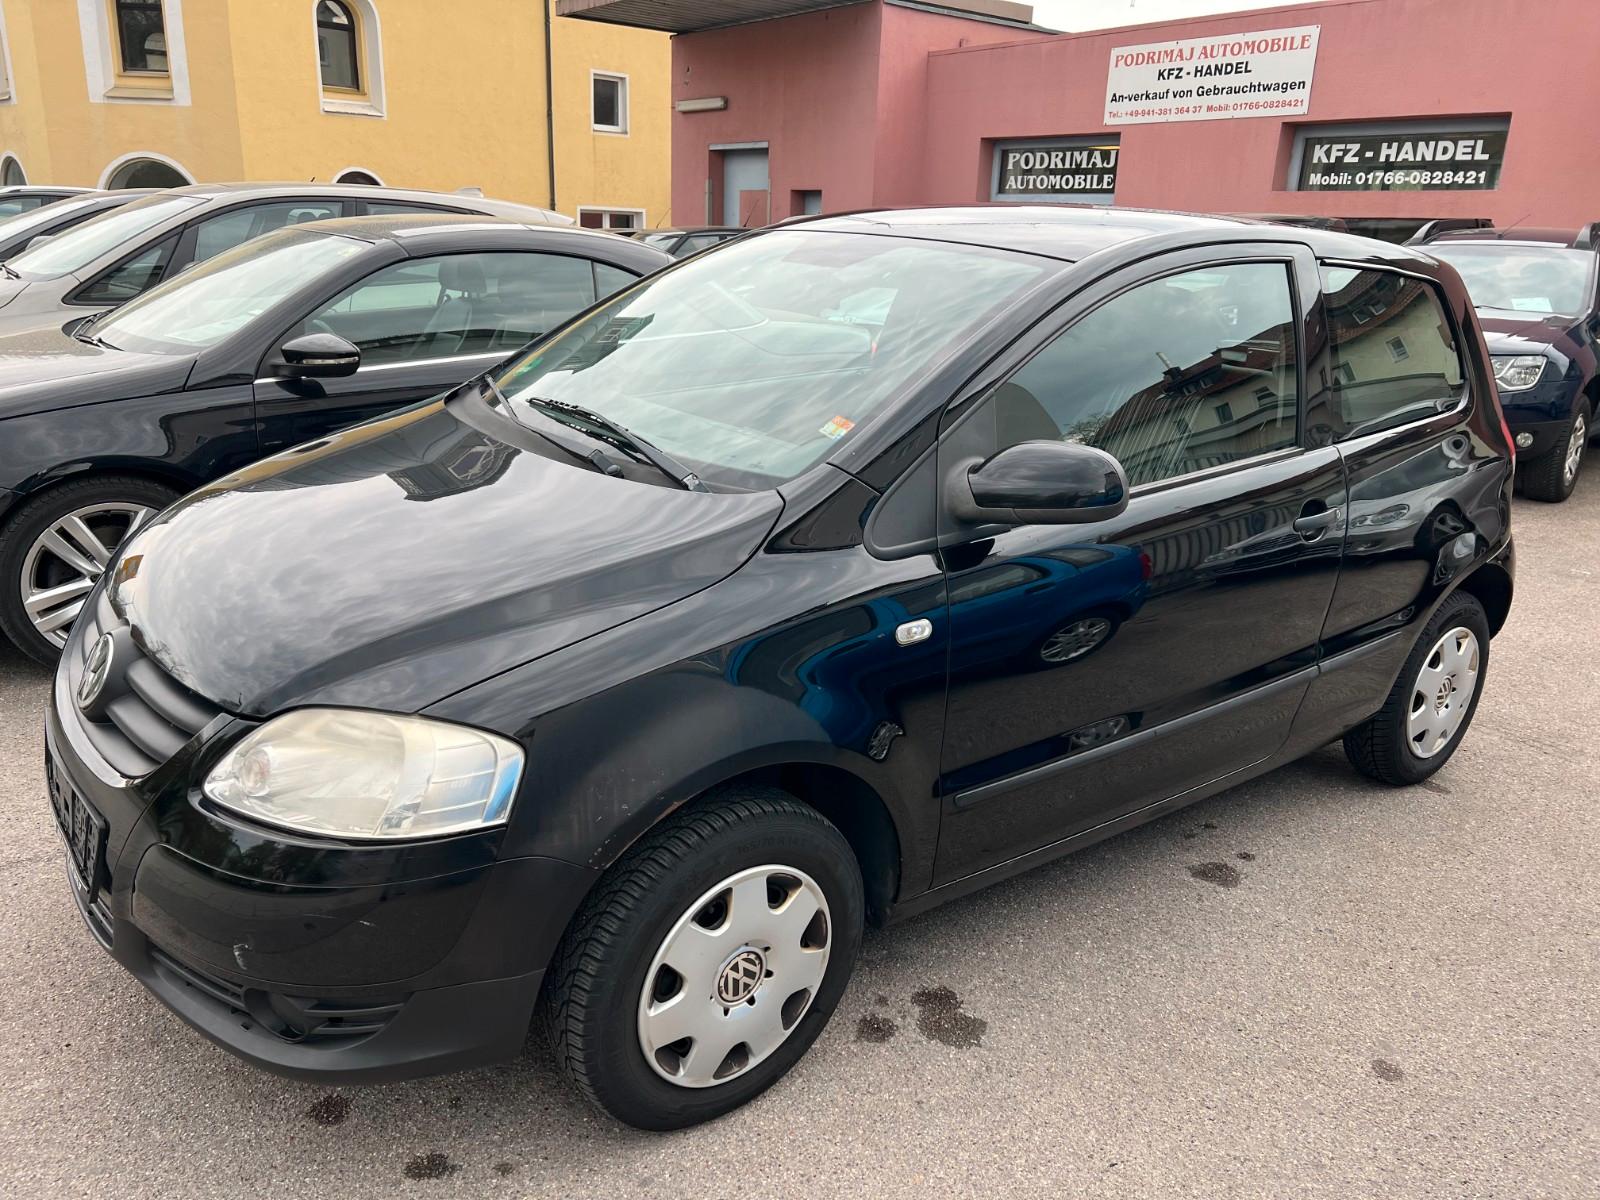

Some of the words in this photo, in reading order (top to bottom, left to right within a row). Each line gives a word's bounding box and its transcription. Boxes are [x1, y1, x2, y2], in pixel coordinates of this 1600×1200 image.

[1114, 46, 1195, 68] PODRIMAJ
[1197, 34, 1311, 60] AUTOMOBILE
[1157, 66, 1184, 81] KFZ
[1194, 61, 1252, 78] HANDEL
[1110, 88, 1170, 103] An-verkauf
[1172, 89, 1193, 99] von
[1196, 79, 1306, 97] Gebrauchtwagen
[1108, 111, 1123, 119] Tel.:
[1174, 106, 1190, 115] 364
[1192, 105, 1202, 113] 37
[1206, 103, 1231, 113] Mobil:
[1232, 98, 1304, 111] 01766-0828421
[1007, 150, 1117, 170] PODRIMAJ
[1312, 143, 1361, 164] KFZ
[1379, 139, 1490, 162] HANDEL
[1005, 174, 1114, 189] AUTOMOBILE
[1309, 172, 1352, 185] Mobil:
[1355, 170, 1487, 185] 01766-0828421
